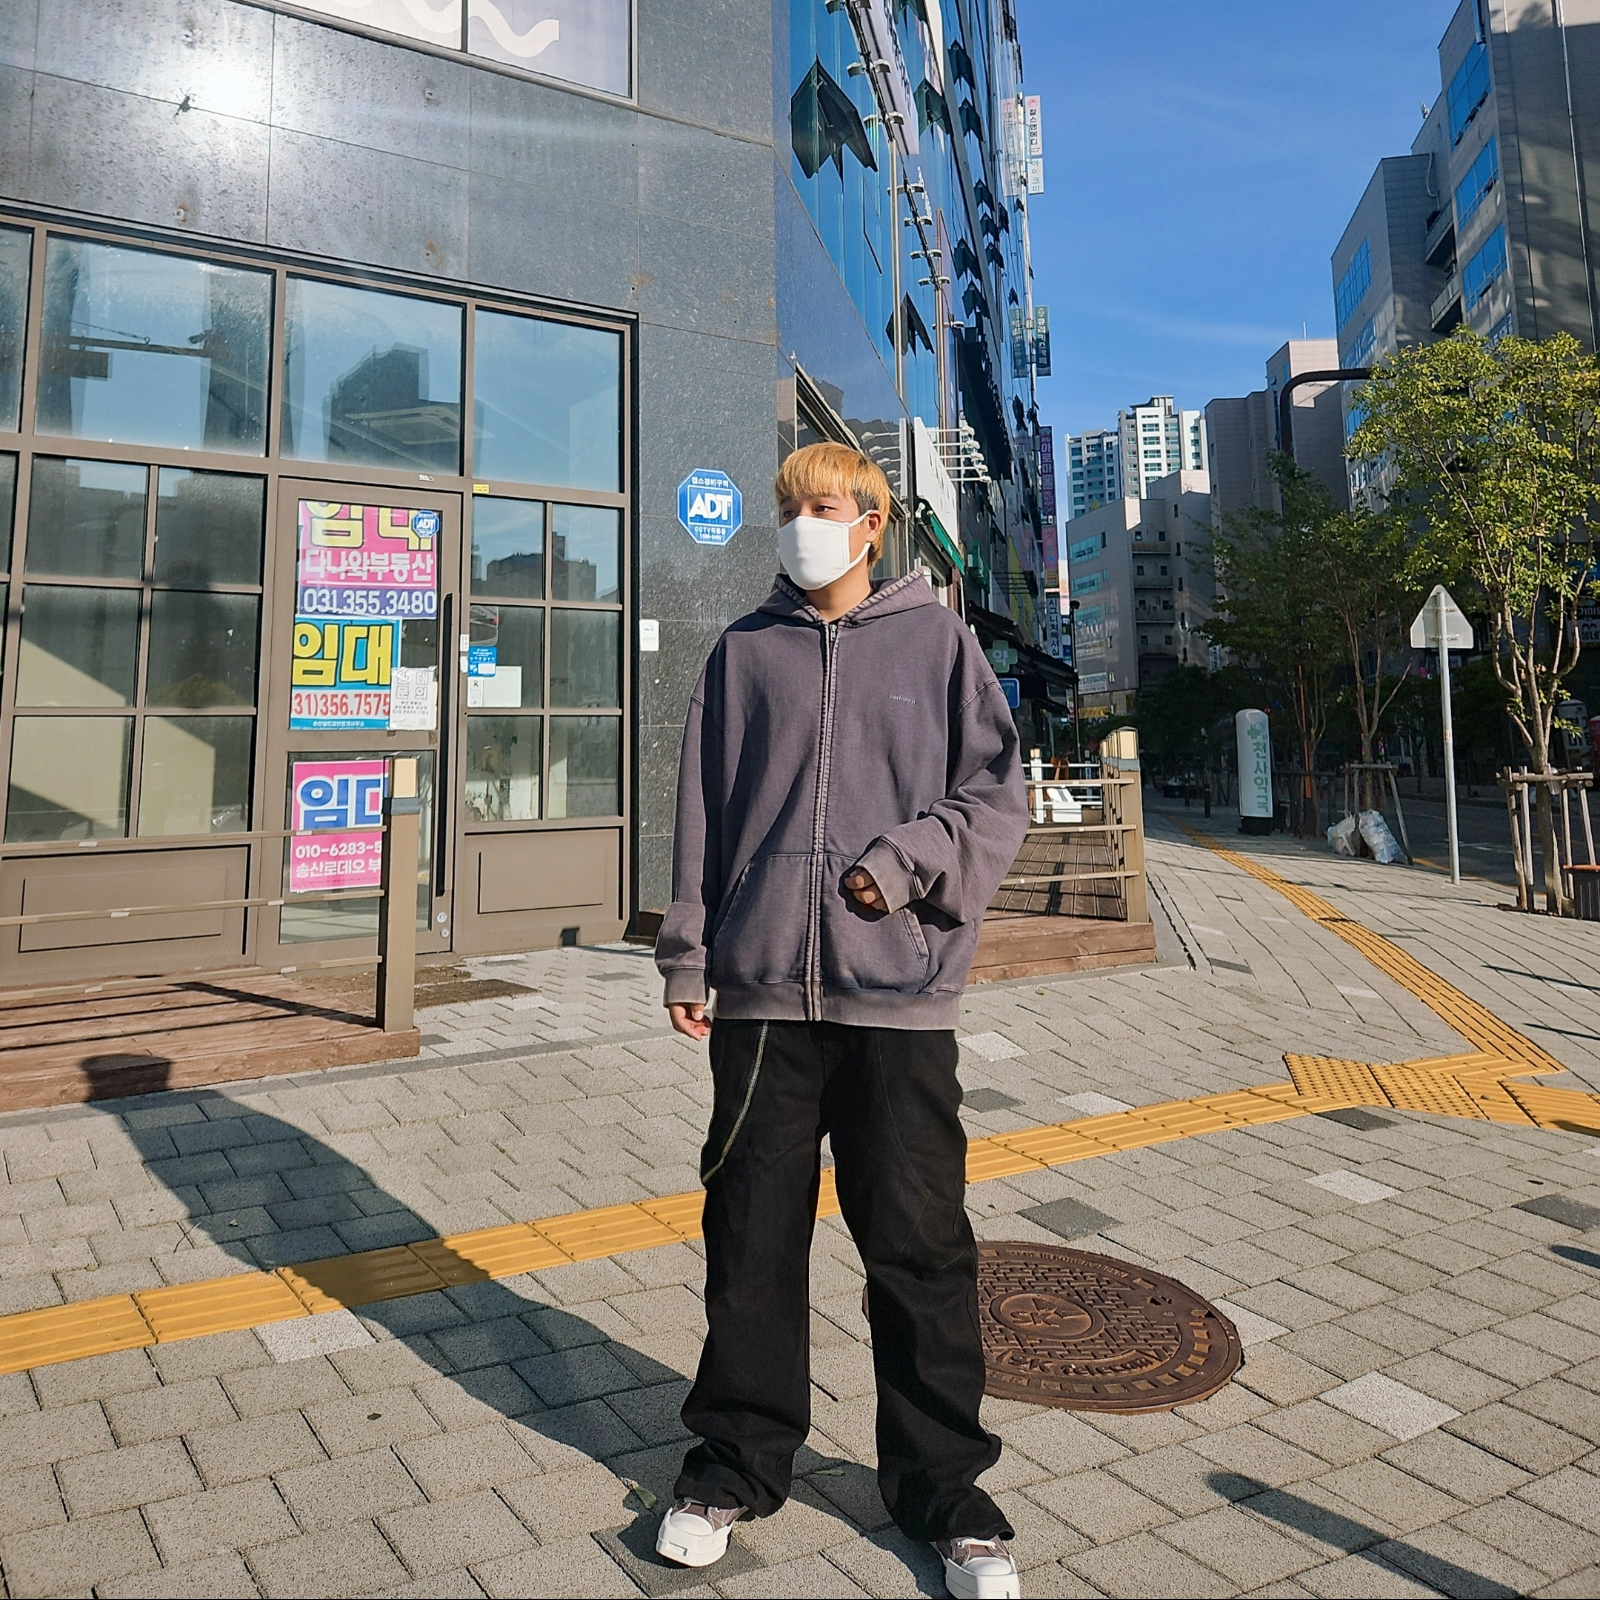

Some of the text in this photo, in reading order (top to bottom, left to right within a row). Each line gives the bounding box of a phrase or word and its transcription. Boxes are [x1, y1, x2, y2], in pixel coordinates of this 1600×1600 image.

[689, 493, 732, 521] ADT
[416, 518, 436, 530] ADT
[305, 550, 434, 582] 다나와부동산
[303, 588, 437, 615] 031.355.3480
[293, 622, 393, 686] 임대
[992, 649, 1009, 667] 약
[1252, 741, 1269, 813] 천사약국
[296, 858, 366, 879] 송산로데오
[1010, 1311, 1060, 1328] SK
[1008, 1355, 1053, 1373] SK
